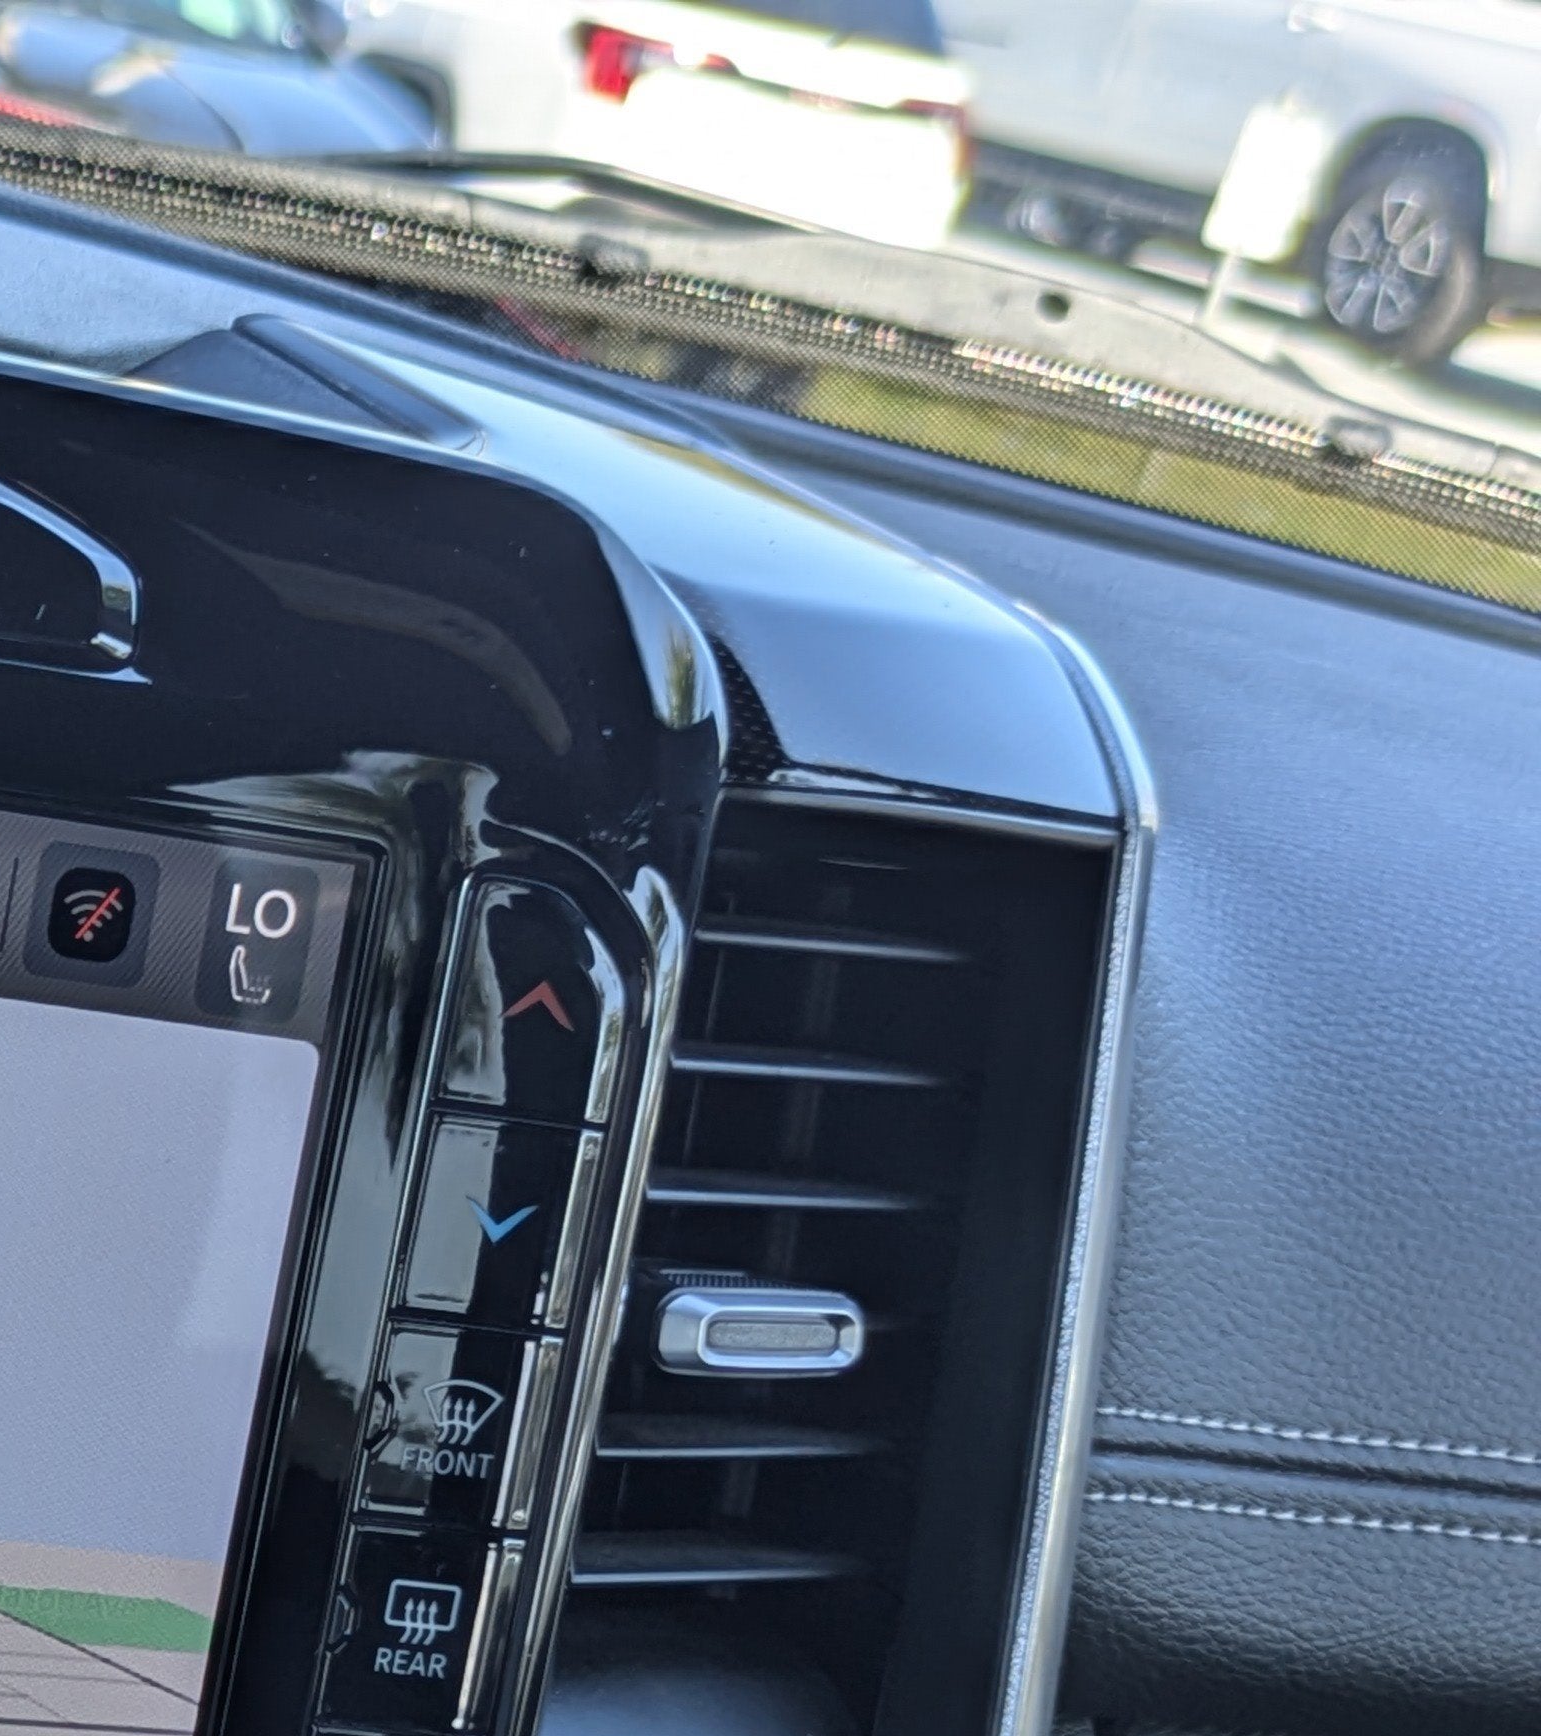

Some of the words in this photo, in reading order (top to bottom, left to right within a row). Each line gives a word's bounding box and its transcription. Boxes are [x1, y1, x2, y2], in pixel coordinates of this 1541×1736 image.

[225, 882, 297, 941] LO
[400, 1446, 495, 1480] FRONT
[374, 1648, 448, 1680] REAR
